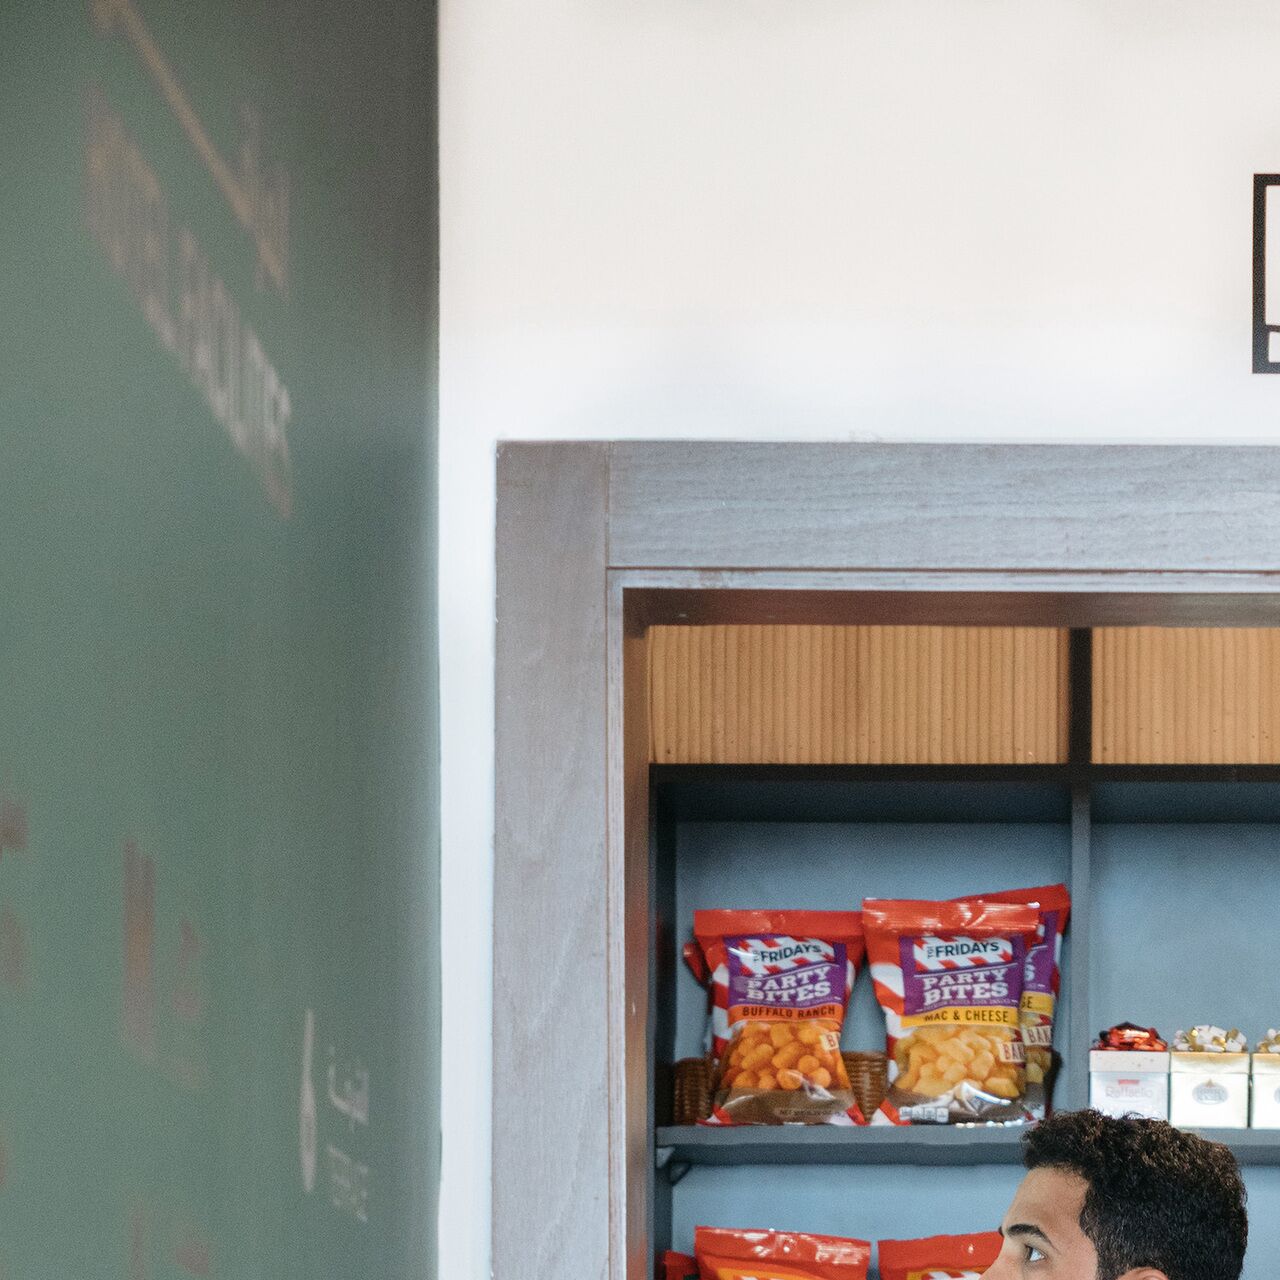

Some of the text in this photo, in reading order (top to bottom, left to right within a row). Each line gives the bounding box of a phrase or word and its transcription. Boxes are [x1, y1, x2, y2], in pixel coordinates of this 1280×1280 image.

[760, 944, 822, 962] FRIDAYS
[935, 942, 999, 957] FRIDAYS
[746, 966, 831, 990] PARTY
[923, 968, 1008, 990] PARTY
[746, 981, 831, 1001] BITES
[923, 981, 1008, 1005] BITES
[743, 1006, 835, 1018] BUFFALO RANCH
[924, 1010, 1008, 1022] MAC & CHEESE
